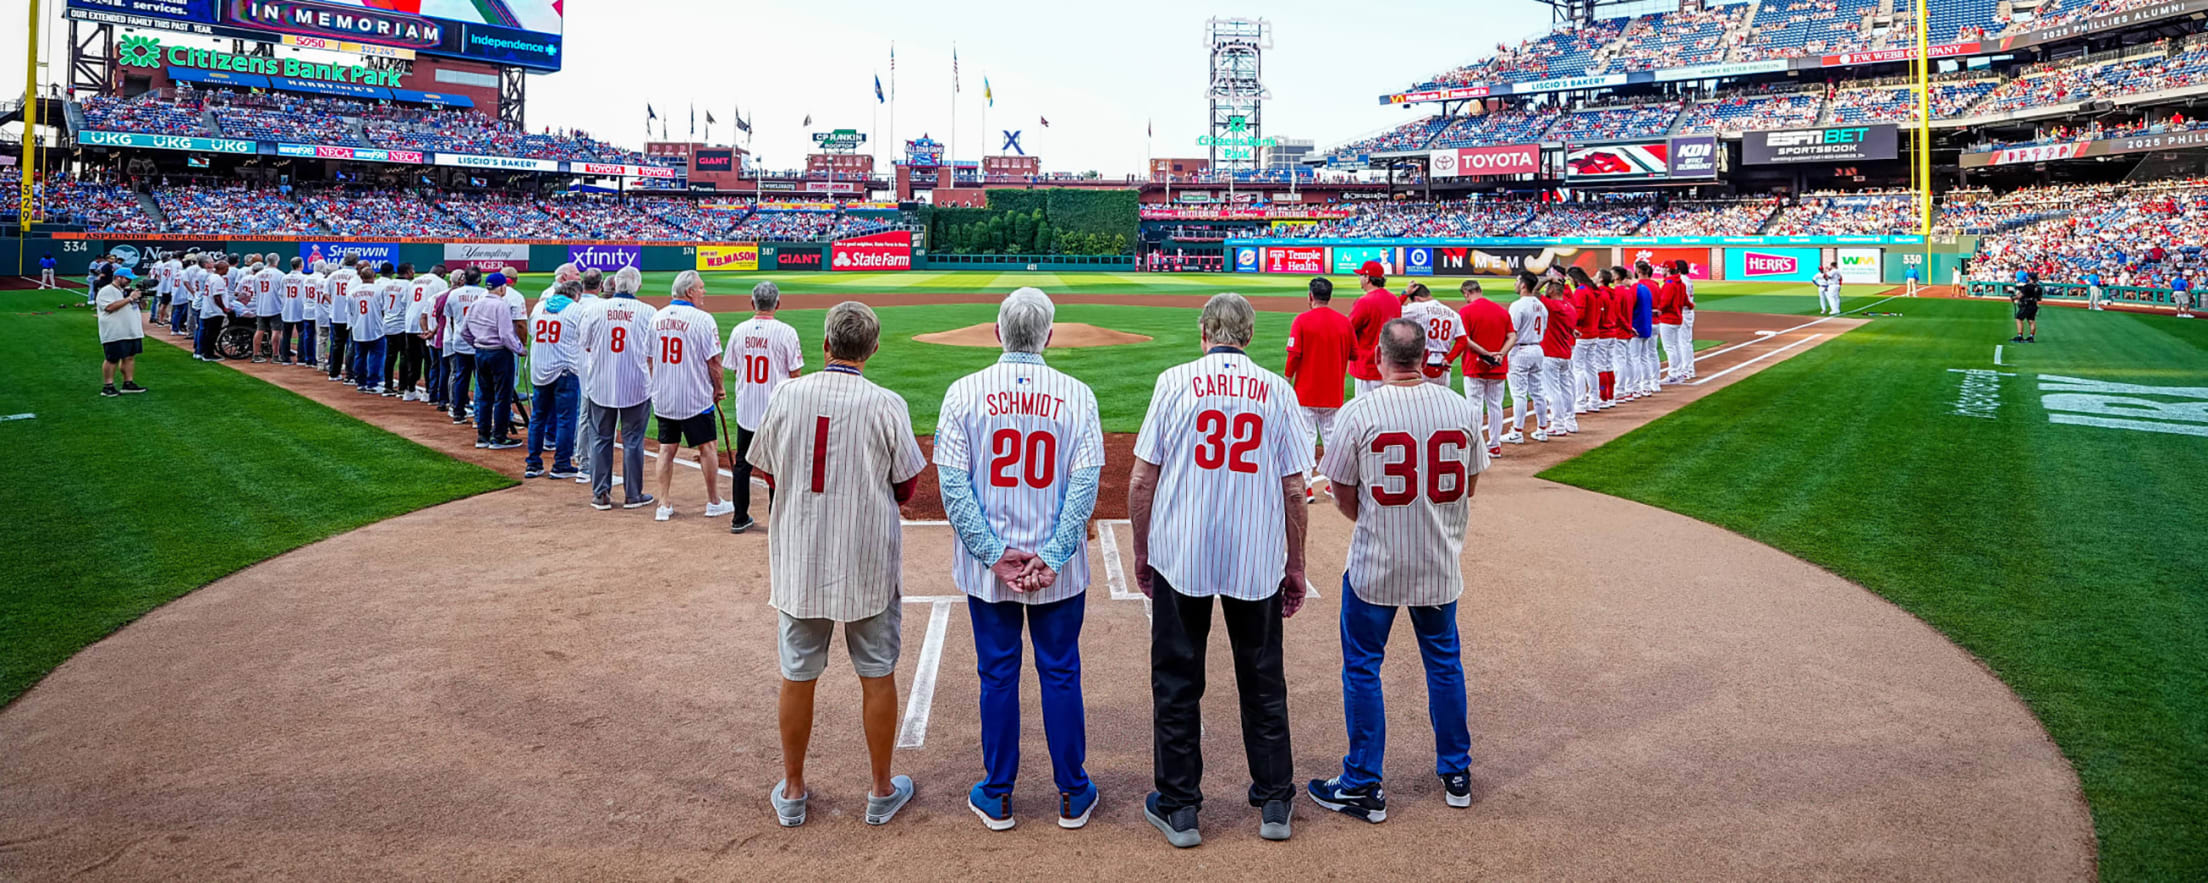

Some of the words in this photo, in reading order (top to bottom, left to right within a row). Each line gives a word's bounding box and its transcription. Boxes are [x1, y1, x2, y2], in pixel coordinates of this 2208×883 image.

[133, 2, 188, 16] services.
[70, 9, 88, 18] OUR
[88, 12, 126, 24] EXTENDED
[128, 16, 153, 27] FAMILY
[154, 20, 170, 29] THIS
[171, 22, 188, 32] PAST
[251, 3, 279, 20] IN
[295, 8, 439, 40] MEMORIAM
[2042, 28, 2068, 40] 2025
[2073, 16, 2128, 33] PHILLIES
[2134, 4, 2186, 21] ALUMNI
[471, 34, 544, 53] Independence
[1874, 50, 1904, 60] WEBB
[168, 46, 278, 75] Citizens
[284, 57, 347, 82] Bank
[350, 65, 402, 88] Park
[1532, 80, 1568, 90] LISCIO'S
[1570, 77, 1606, 88] BAKERY
[91, 132, 132, 145] UKG
[153, 136, 192, 149] UKG
[1198, 136, 1244, 146] Citizens
[1247, 136, 1277, 148] Bank
[1766, 130, 1824, 146] ESPN
[1824, 128, 1869, 144] BET
[2128, 138, 2160, 149] 2025
[211, 139, 248, 152] UKG
[318, 146, 352, 158] NECA
[1678, 144, 1712, 158] KDI
[1778, 144, 1857, 155] SPORTSBOOK
[390, 150, 422, 162] NECA
[1224, 149, 1250, 159] Park
[458, 156, 499, 166] LISCIO'S
[501, 158, 538, 168] BAKERY
[698, 156, 729, 166] GIANT
[1462, 152, 1533, 170] TOYOTA
[588, 164, 622, 174] TOYOTA
[640, 168, 674, 177] TOYOTA
[64, 241, 88, 252] 334
[461, 245, 514, 258] Yuengling
[683, 247, 694, 255] 374
[572, 246, 637, 268] xfinity
[778, 254, 821, 264] GIANT
[1287, 250, 1320, 260] Temple
[1842, 256, 1875, 265] WM
[1904, 254, 1922, 264] 330
[469, 260, 504, 270] LAGER
[1288, 261, 1319, 271] Health
[1443, 256, 1463, 268] IN
[1749, 257, 1792, 270] HERR'S
[260, 281, 270, 292] 13
[287, 286, 298, 298] 19
[305, 286, 315, 299] 18
[414, 287, 423, 302] 6
[360, 300, 368, 315] 8
[389, 294, 395, 310] 7
[607, 309, 634, 322] BOONE
[536, 320, 562, 344] 29
[656, 320, 690, 334] LUZINSKI
[1428, 318, 1452, 341] 38
[1534, 316, 1541, 335] 4
[611, 327, 626, 353] 8
[745, 336, 768, 350] BOWA
[660, 336, 682, 364] 19
[745, 355, 769, 384] 10
[1193, 374, 1270, 404] CARLTON
[987, 392, 1064, 420] SCHMIDT
[1195, 409, 1263, 474] 32
[811, 416, 830, 493] 1
[990, 428, 1056, 489] 20
[1370, 430, 1467, 507] 36
